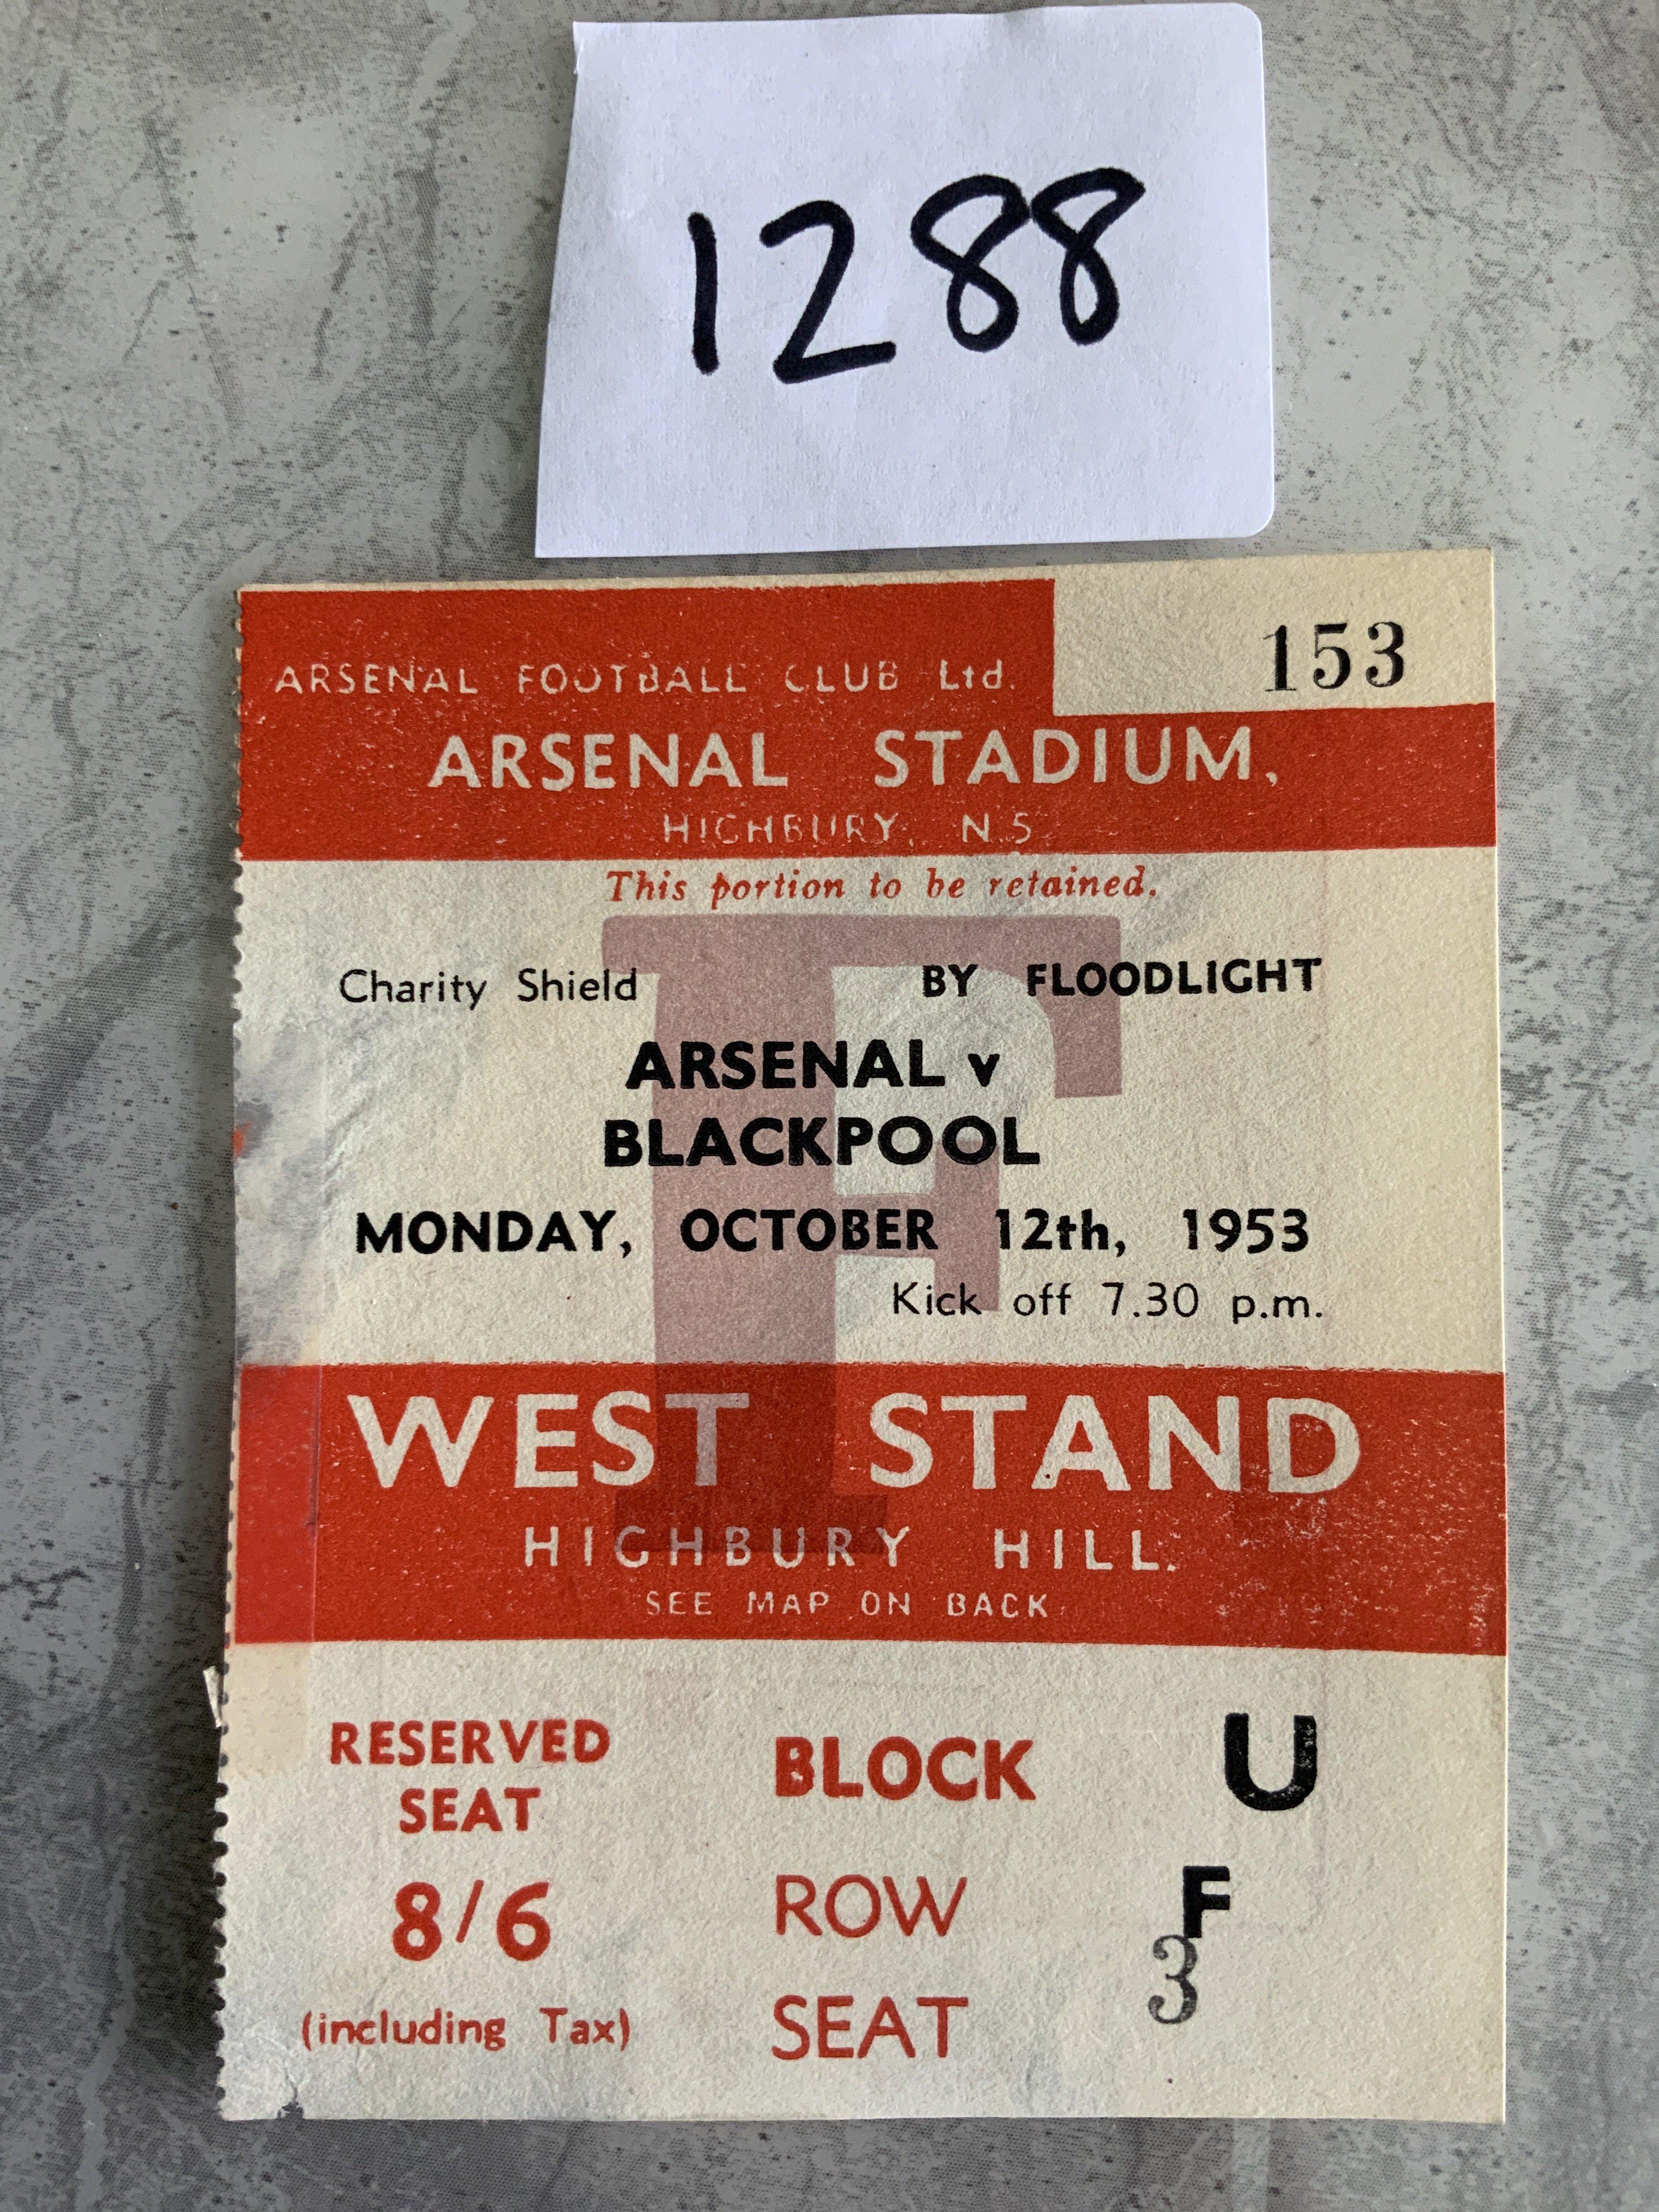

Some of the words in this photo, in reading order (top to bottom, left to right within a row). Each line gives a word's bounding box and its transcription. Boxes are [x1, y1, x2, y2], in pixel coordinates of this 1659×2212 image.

[688, 167, 1145, 384] 1288
[275, 662, 478, 695] ARSENAL
[518, 660, 746, 695] FOOTBALL
[785, 660, 898, 693] CLUB
[1262, 621, 1405, 692] 153
[427, 733, 788, 791] ARSENAL
[874, 726, 1278, 788] STADIUM,
[607, 871, 687, 902] This
[711, 869, 846, 910] portion
[871, 872, 901, 900] to
[927, 867, 964, 899] be
[989, 865, 1158, 899] retained.
[339, 968, 487, 1011] Charity
[517, 967, 637, 1002] Shield
[922, 963, 978, 997] BY
[1027, 957, 1323, 997] FLOODLIGHT
[625, 1039, 945, 1090] ARSENAL
[968, 1053, 1000, 1088] v
[605, 1115, 1040, 1167] BLACKPOOL
[356, 1210, 632, 1259] MONDAY,
[680, 1208, 938, 1252] OCTOBER
[995, 1207, 1126, 1256] 12th,
[1182, 1208, 1309, 1254] 1953
[893, 1282, 983, 1316] Kick
[1013, 1283, 1072, 1317] off
[1101, 1282, 1199, 1318] 7.30
[1232, 1294, 1324, 1323] p.m.
[347, 1390, 750, 1488] WEST
[870, 1392, 1361, 1493] STAND
[525, 1525, 910, 1568] HIGHBURY
[646, 1590, 713, 1616] SEE
[746, 1590, 830, 1615] MAP
[861, 1590, 911, 1616] ON
[947, 1591, 1048, 1618] BACK
[330, 1718, 610, 1766] RESERVED
[775, 1736, 1036, 1801] BLOCK
[1223, 1712, 1318, 1812] U
[399, 1787, 541, 1835] SEAT
[392, 1880, 551, 1962] 8/6
[776, 1875, 968, 1938] ROW
[1182, 1865, 1231, 1939] F
[771, 1994, 969, 2061] SEAT
[1147, 1934, 1198, 2025] 3
[301, 2008, 506, 2051] (including
[540, 2007, 630, 2052] Tax)
